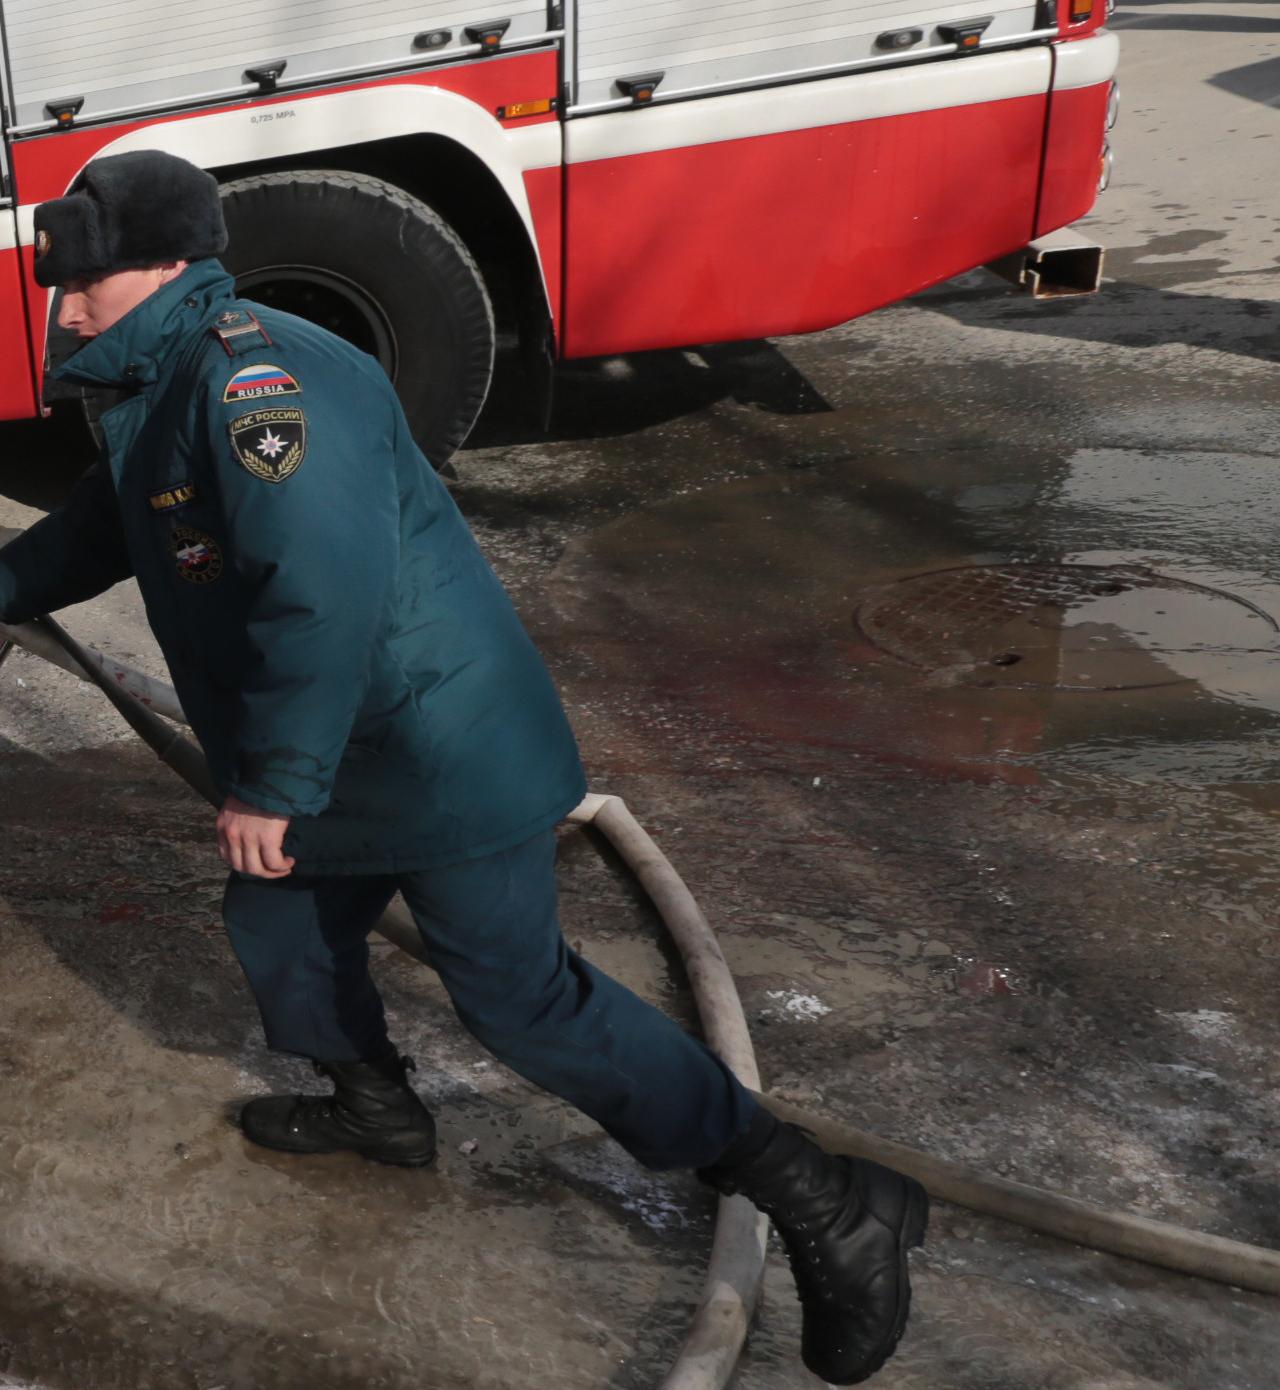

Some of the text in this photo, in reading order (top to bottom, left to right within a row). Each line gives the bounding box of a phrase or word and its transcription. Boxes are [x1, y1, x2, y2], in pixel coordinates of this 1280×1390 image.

[237, 385, 284, 397] RUSSIA
[234, 411, 300, 429] МЧС РОССИИ
